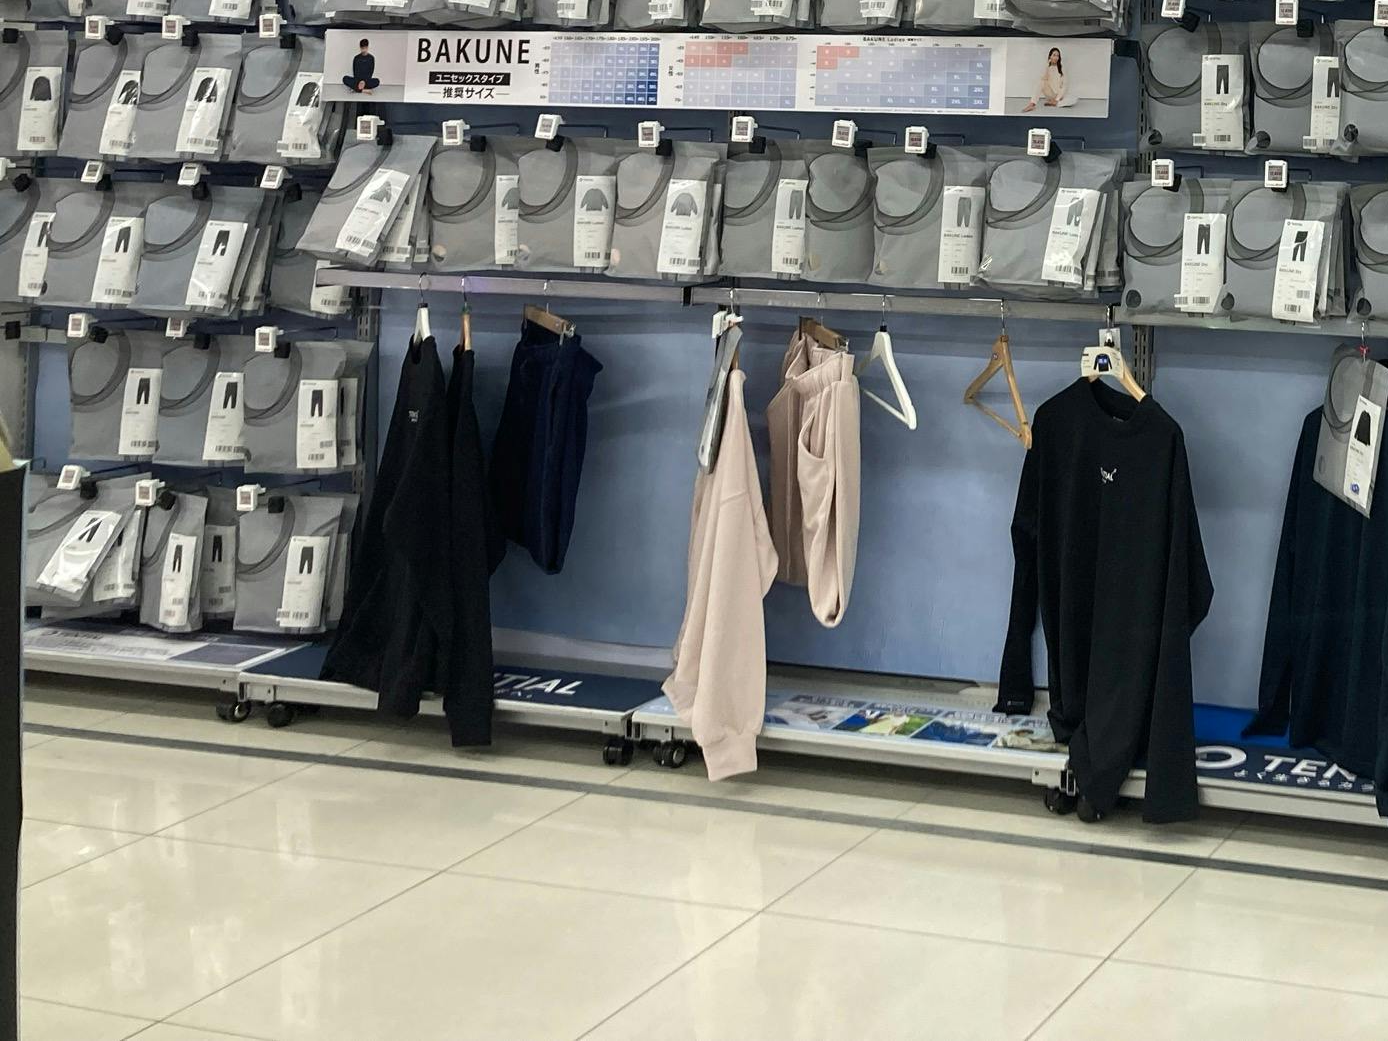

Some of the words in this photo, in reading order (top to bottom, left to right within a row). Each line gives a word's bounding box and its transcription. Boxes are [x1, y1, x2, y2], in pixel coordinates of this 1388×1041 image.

[417, 38, 531, 64] BAKUNE
[434, 72, 505, 85] ユニセックスタイプ
[442, 86, 496, 100] 推奨サイズ
[494, 672, 583, 695] TIAL
